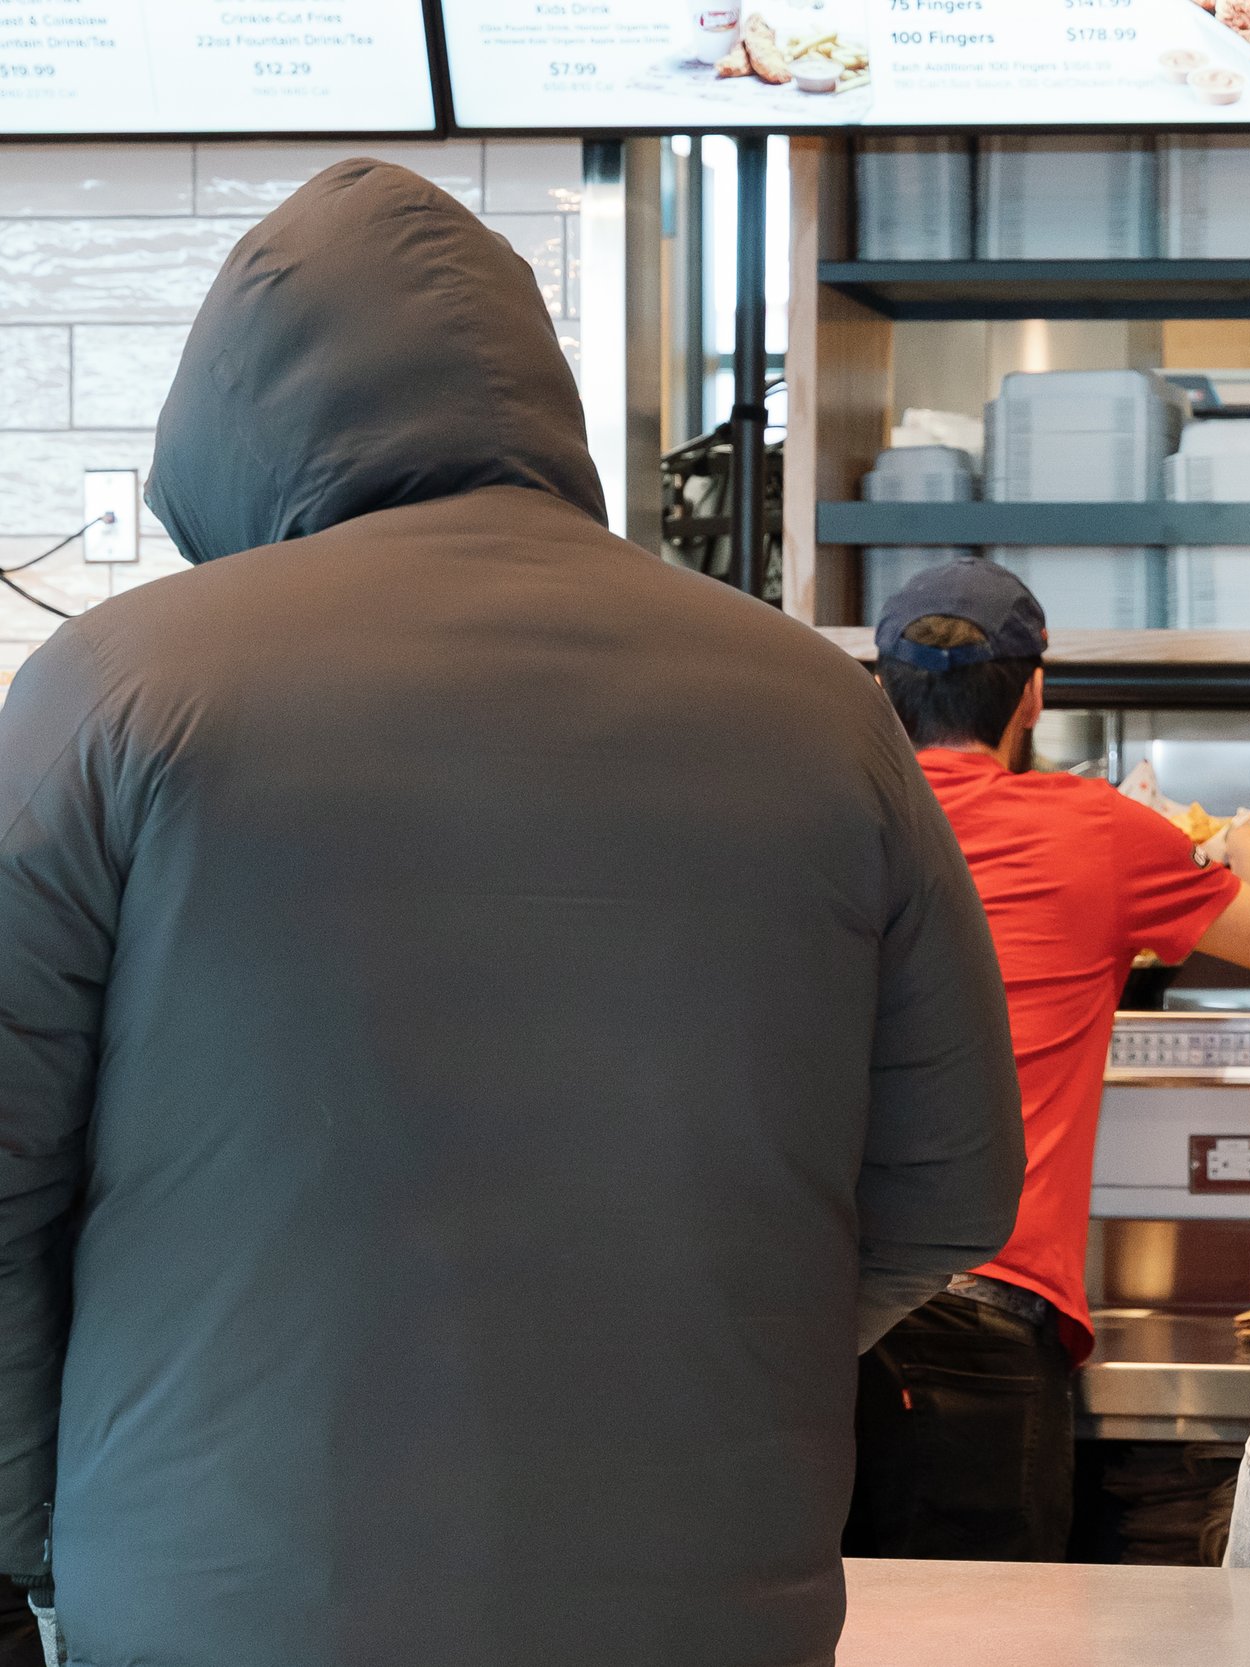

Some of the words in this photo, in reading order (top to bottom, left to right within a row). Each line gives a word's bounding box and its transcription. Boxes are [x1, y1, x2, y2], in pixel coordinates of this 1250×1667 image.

[890, 31, 923, 44] 100
[928, 31, 996, 47] Fingers
[1065, 28, 1138, 42] $178.99
[549, 61, 597, 76] $7.99
